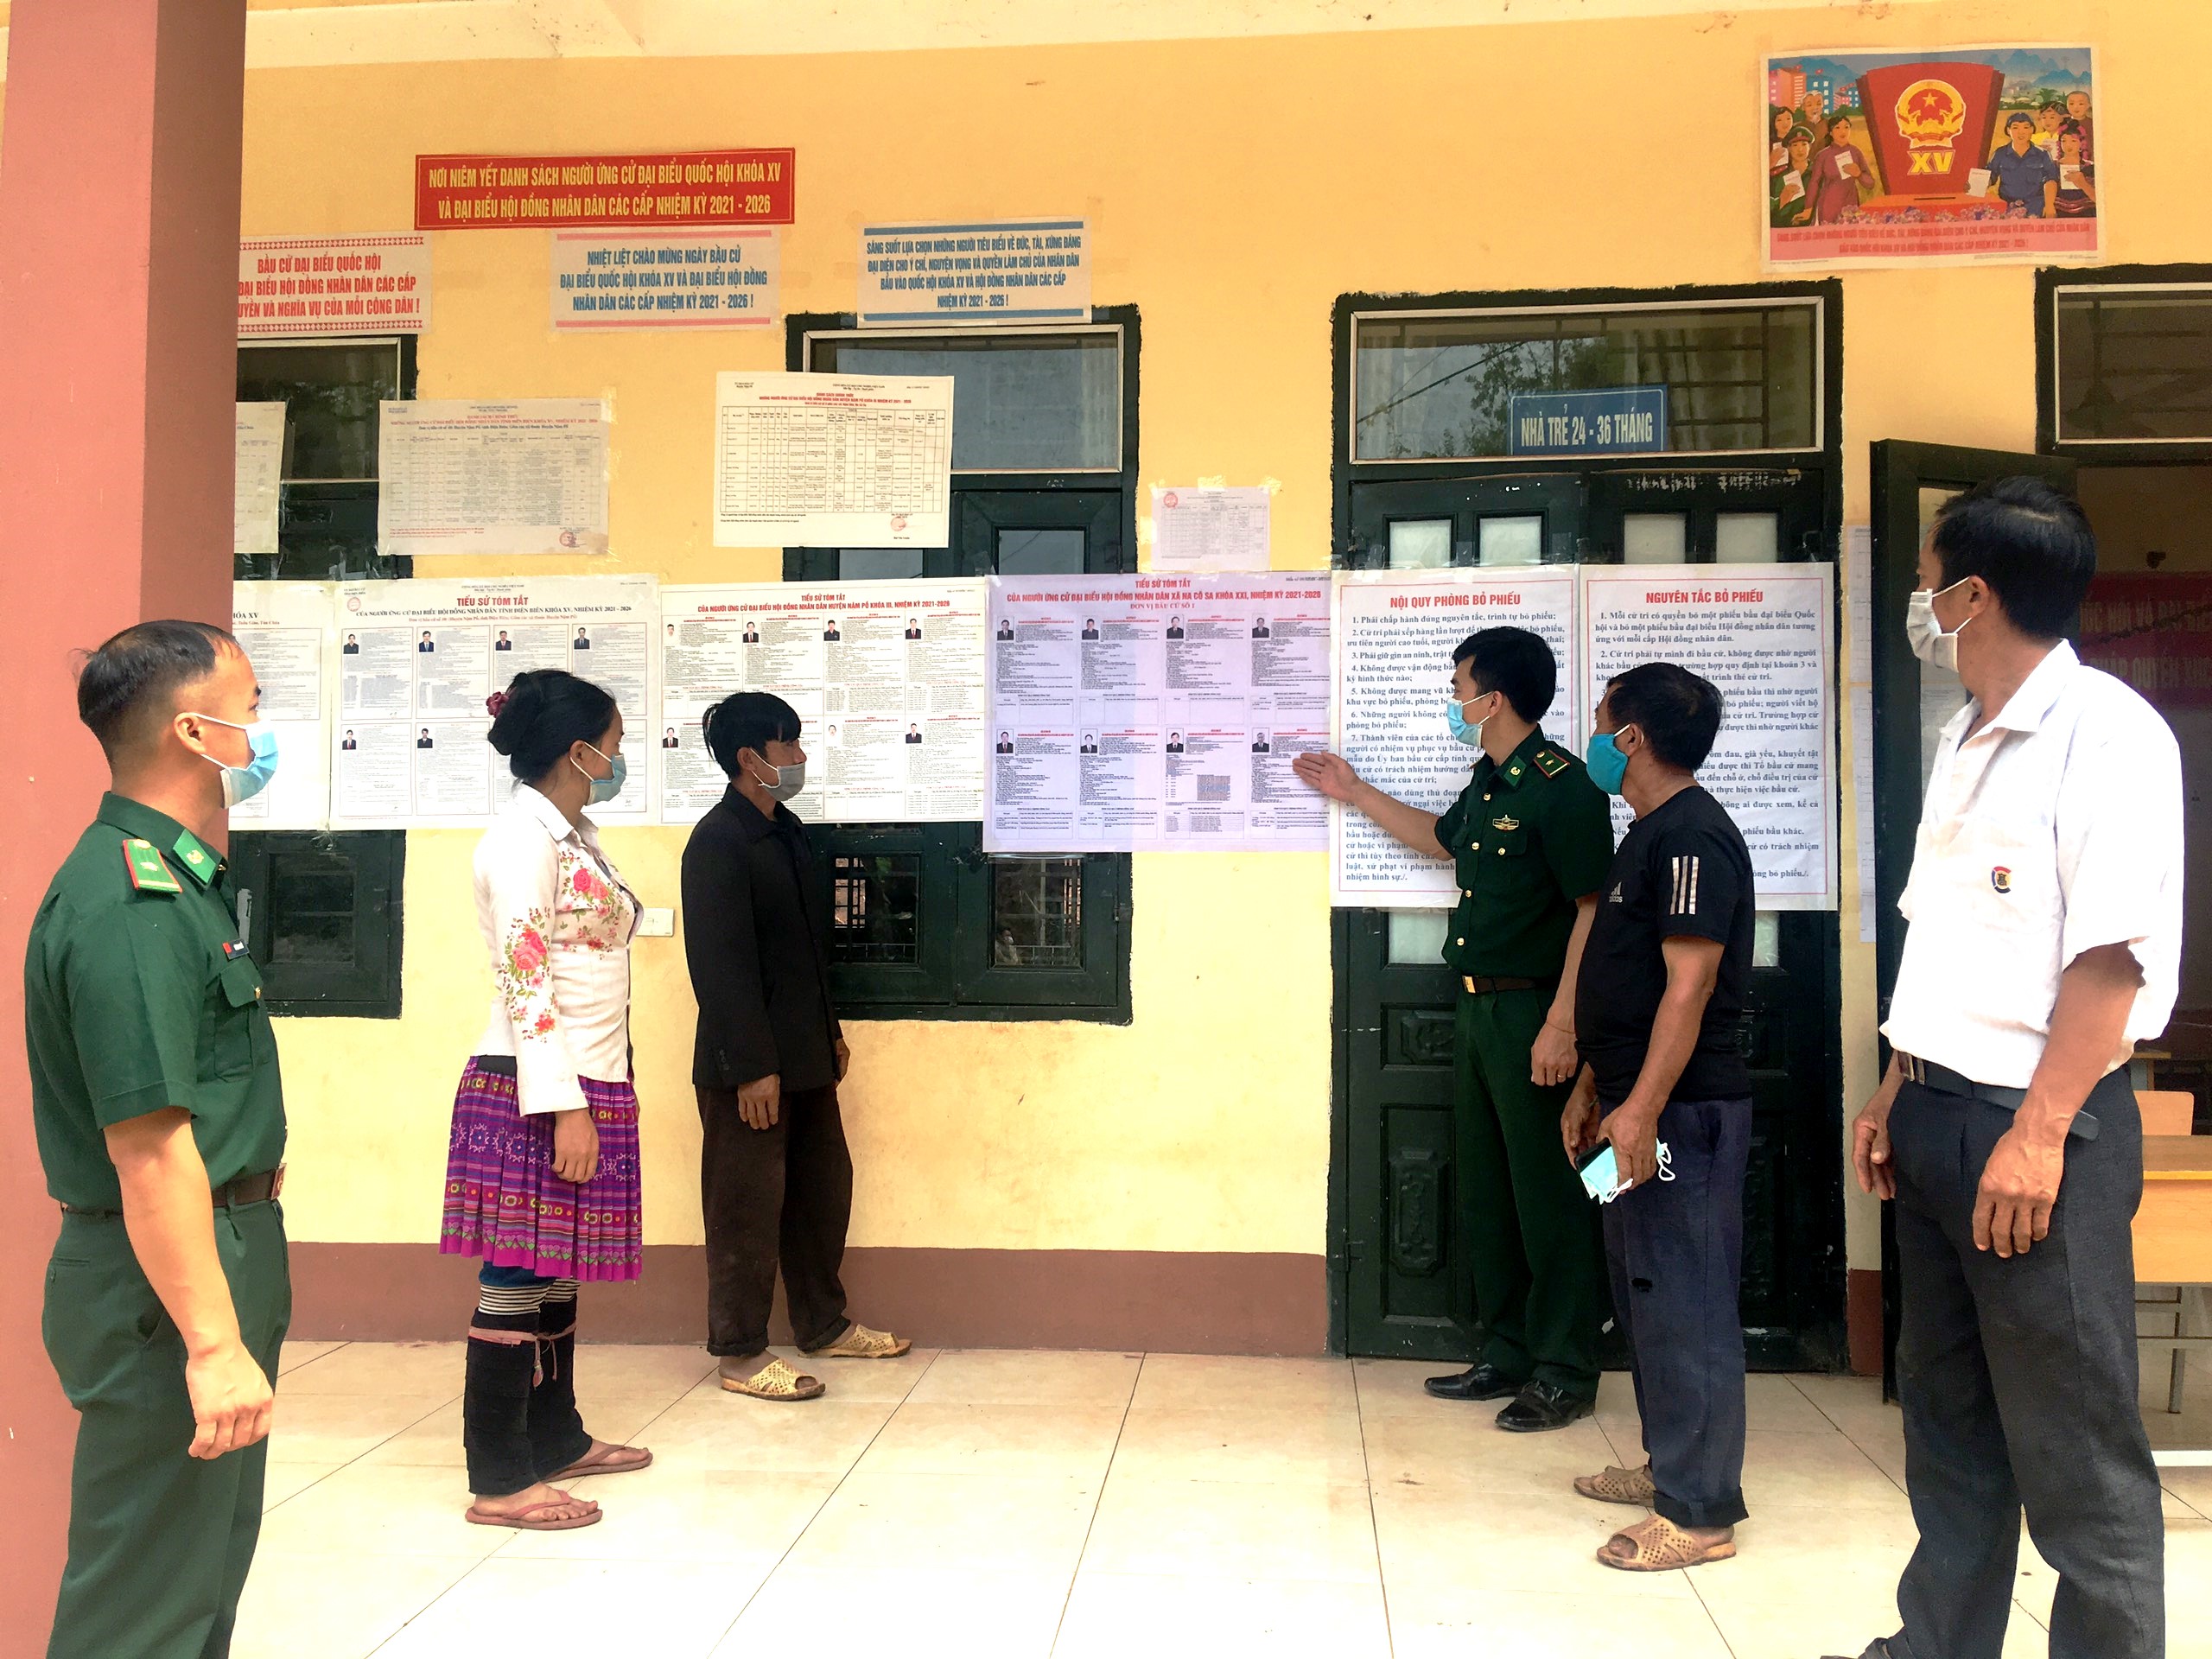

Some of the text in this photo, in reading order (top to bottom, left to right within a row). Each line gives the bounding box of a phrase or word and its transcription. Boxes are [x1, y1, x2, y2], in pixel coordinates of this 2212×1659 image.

[429, 157, 781, 188] NƠI NIÊM YẾT DANH SÁCH NGƯỜI ỨNG CỬ ĐẠI BIỂU QUỐC HỘI KHÓA XV
[1908, 150, 1955, 175] XV
[438, 196, 451, 219] VÀ
[454, 200, 471, 222] ĐẠI
[474, 192, 498, 218] BIỂU
[500, 194, 518, 221] HỘI
[520, 192, 549, 217] ĐỒNG
[551, 194, 581, 216] NHÂN
[583, 193, 606, 215] DÂN
[608, 193, 629, 215] CÁC
[632, 190, 653, 215] CẤP
[656, 192, 690, 219] NHIỆM
[693, 192, 707, 214] KỲ
[709, 195, 734, 214] 2021
[745, 194, 770, 213] 2026
[257, 252, 381, 275] BẦU CỬ ĐẠI BIỂU QUỐC HỘI
[587, 244, 741, 268] NHIỆT LIỆT CHÀO MỪNG NGÀY BẦU CỬ
[256, 275, 276, 296] BIỂU
[279, 276, 296, 297] HỘI
[298, 276, 323, 295] ĐỒNG
[326, 275, 352, 293] NHÂN
[354, 275, 373, 292] DÂN
[375, 276, 395, 292] CÁC
[397, 271, 416, 291] CẤP
[560, 265, 767, 291] ĐẠI BIỂU QUỐC HỘI KHÓA XV VÀ ĐẠI BIỂU HỘI ĐỒNG
[238, 298, 260, 318] UYỀN
[263, 300, 275, 317] VÀ
[277, 299, 306, 317] NGHĨA
[308, 301, 321, 318] VỤ
[323, 296, 342, 315] CỦA
[345, 296, 363, 315] MỖI
[366, 296, 391, 315] CÔNG
[394, 296, 413, 314] DÂN
[573, 293, 596, 310] NHÂN
[598, 292, 616, 310] DÂN
[618, 293, 635, 310] CÁC
[637, 290, 654, 310] CẤP
[657, 291, 683, 313] NHIỆM
[686, 291, 696, 308] KỲ
[699, 294, 718, 308] 2021
[728, 294, 747, 308] 2026
[969, 295, 983, 307] 2021
[988, 294, 1004, 307] 2026
[1521, 410, 1544, 446] NHÀ
[1548, 404, 1568, 446] TRẺ
[1572, 416, 1586, 445] 24
[1597, 415, 1611, 444] 36
[1614, 406, 1652, 443] THÁNG
[1390, 590, 1520, 610] NỘI QUY PHÒNG BỎ PHIẾU
[1646, 588, 1763, 603] NGUYÊN TẮC BỎ PHIẾU
